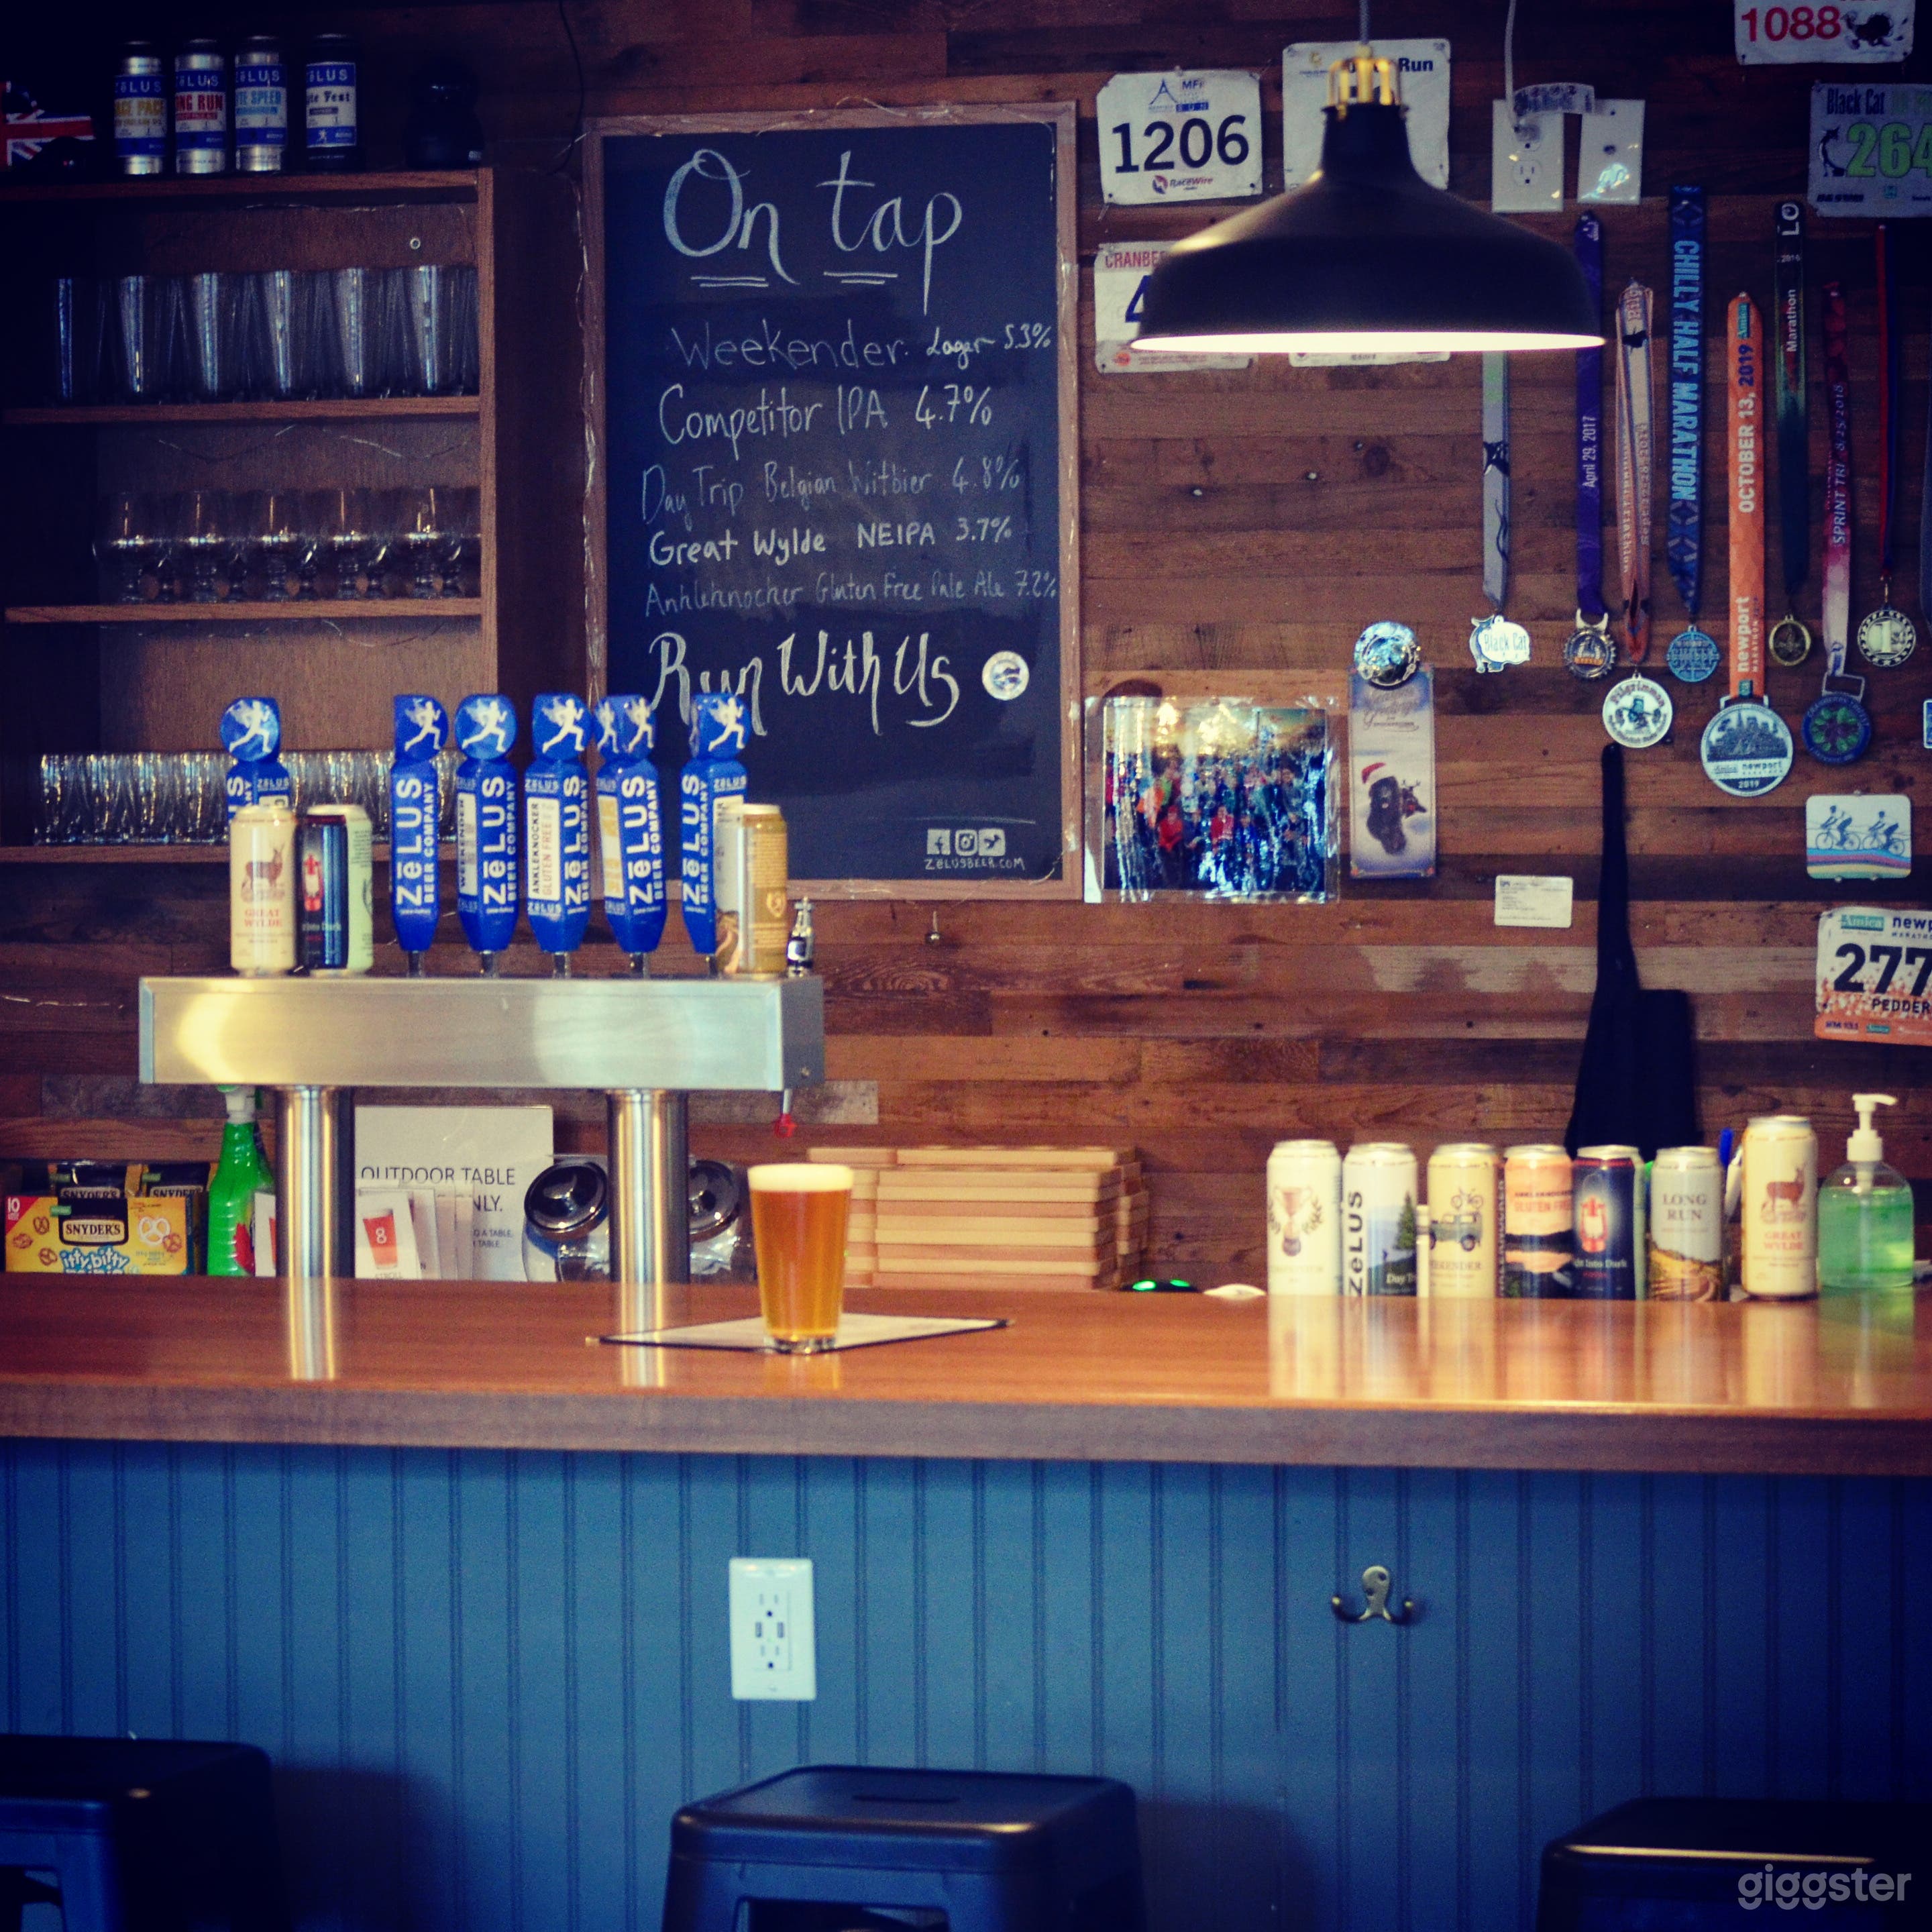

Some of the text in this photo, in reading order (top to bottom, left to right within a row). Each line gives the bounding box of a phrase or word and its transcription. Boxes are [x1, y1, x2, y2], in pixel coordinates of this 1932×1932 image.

[1741, 5, 1841, 42] 1088
[1399, 58, 1434, 72] Run
[198, 94, 223, 112] RUN
[1827, 89, 1861, 115] Black
[1866, 88, 1886, 115] Cat
[1112, 115, 1250, 174] 1206
[663, 148, 963, 317] On tap
[1786, 289, 1798, 352] Marathon
[926, 327, 996, 370] Lager
[1005, 323, 1053, 350] 5.3%
[1670, 240, 1701, 501] CHILLY HALF MARATHON
[659, 384, 993, 461] Competitor IPA 4.7%
[1582, 416, 1597, 440] 2017
[1737, 344, 1756, 513] OCTOBER 13, 2019
[642, 464, 693, 531] Day
[692, 465, 744, 516] Trip
[764, 461, 837, 511] Belgian
[952, 456, 1020, 492] 4.8%
[1582, 468, 1599, 488] April
[1835, 463, 1846, 486] TRI
[649, 516, 1012, 566] Great Wylde NEIPA 3.7%
[1833, 490, 1846, 545] SPRINT
[884, 572, 924, 601] Free
[974, 570, 1005, 598] Ale
[1015, 569, 1057, 598] 7.2%
[1484, 632, 1527, 652] Black Cat
[1736, 596, 1752, 673] newport
[649, 630, 960, 737] Run With Us
[423, 782, 435, 904] BEER COMPANY
[506, 781, 517, 902] BEER COMPANY
[531, 802, 540, 895] ANKLEKNOCKER
[580, 780, 590, 902] BEER COMPANY
[646, 780, 664, 900] BEER COMPANY
[699, 780, 709, 904] BEER COMPANY
[1833, 943, 1932, 998] 277
[1872, 998, 1931, 1014] PEDDER
[361, 1166, 516, 1186] OUTDOOR TABLE
[1662, 1193, 1707, 1205] LONG
[7, 1197, 21, 1213] 10
[65, 1224, 121, 1236] SNYDER'S
[1667, 1209, 1703, 1221] RUN
[375, 1227, 388, 1245] 8
